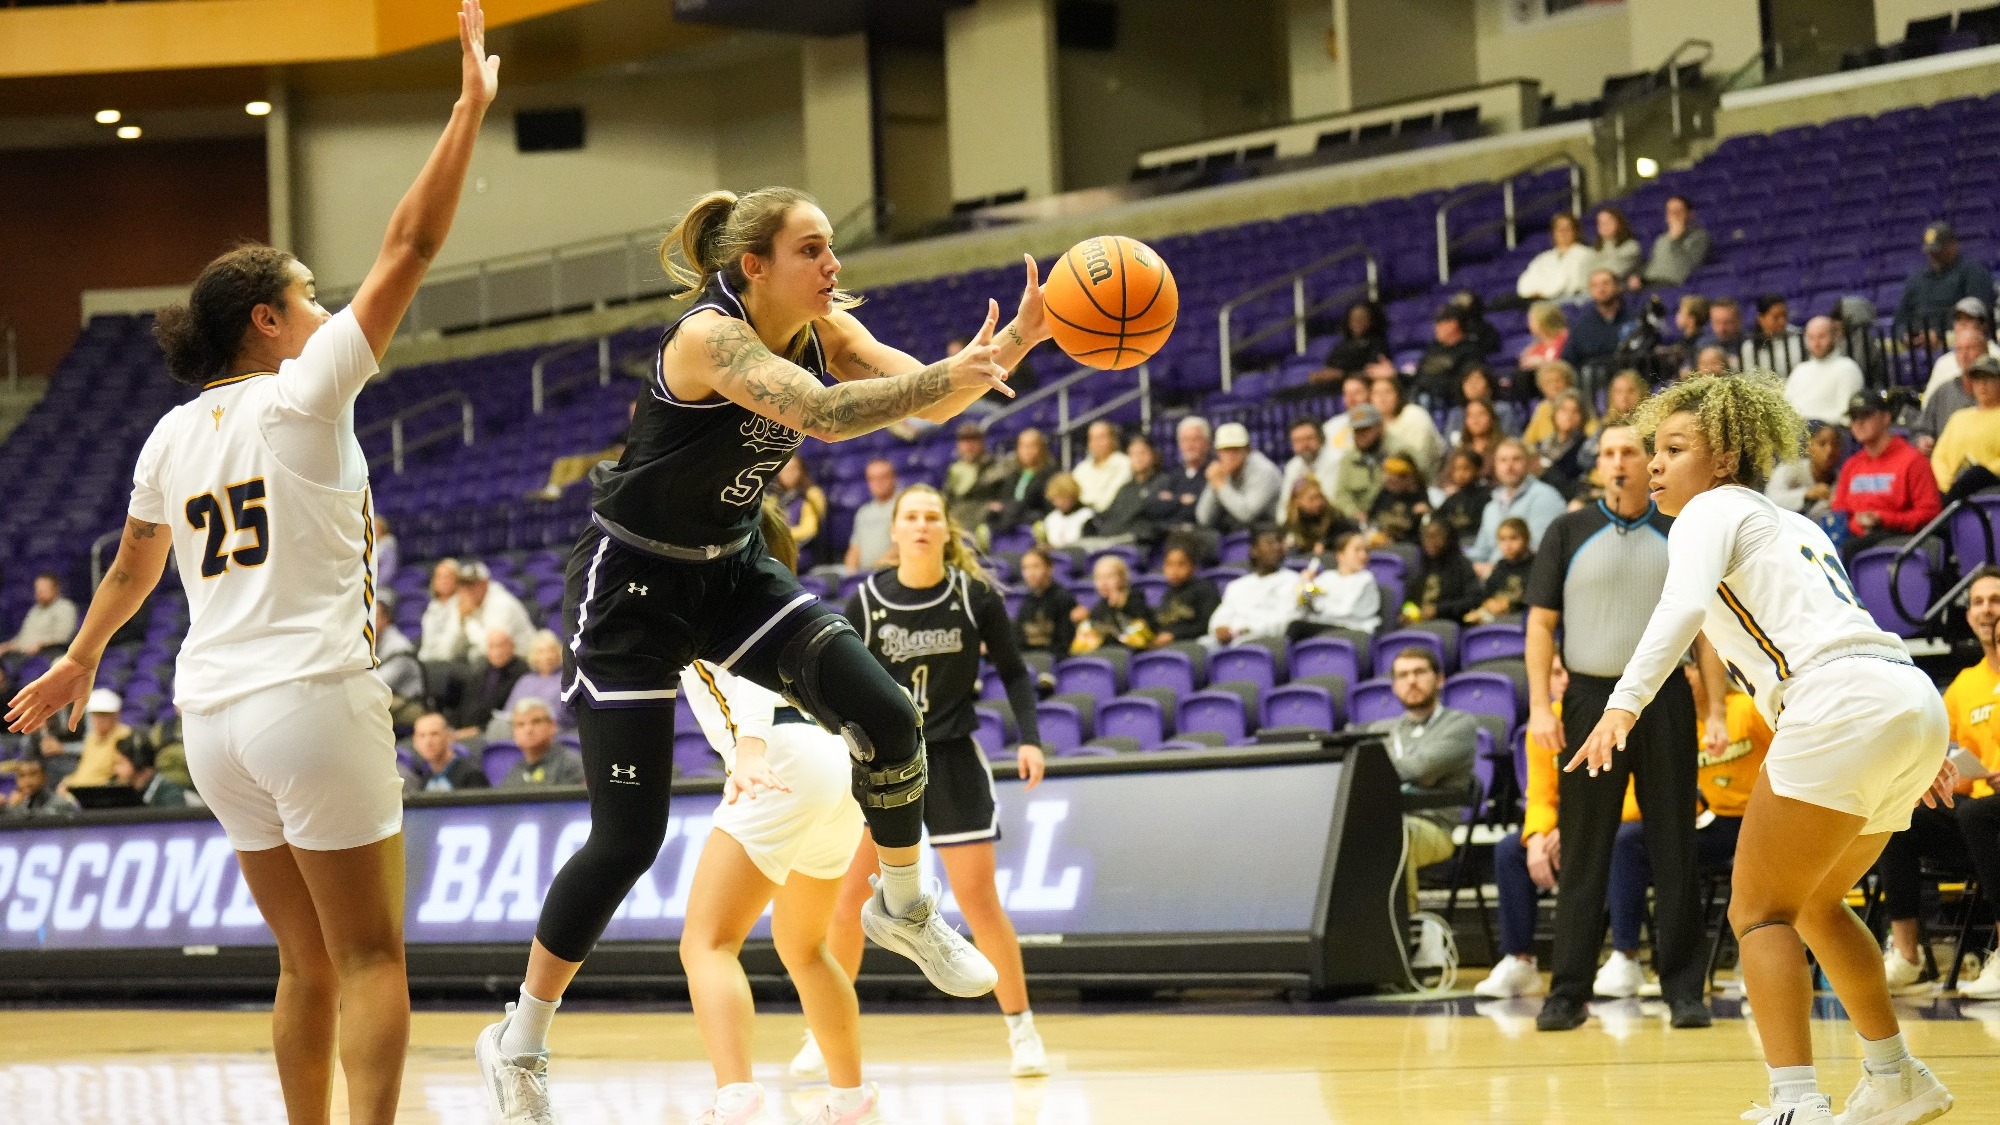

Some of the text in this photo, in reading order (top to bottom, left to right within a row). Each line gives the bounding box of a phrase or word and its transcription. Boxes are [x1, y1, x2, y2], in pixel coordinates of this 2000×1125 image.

[720, 460, 782, 507] 5
[184, 475, 270, 581] 25
[911, 664, 930, 713] 1
